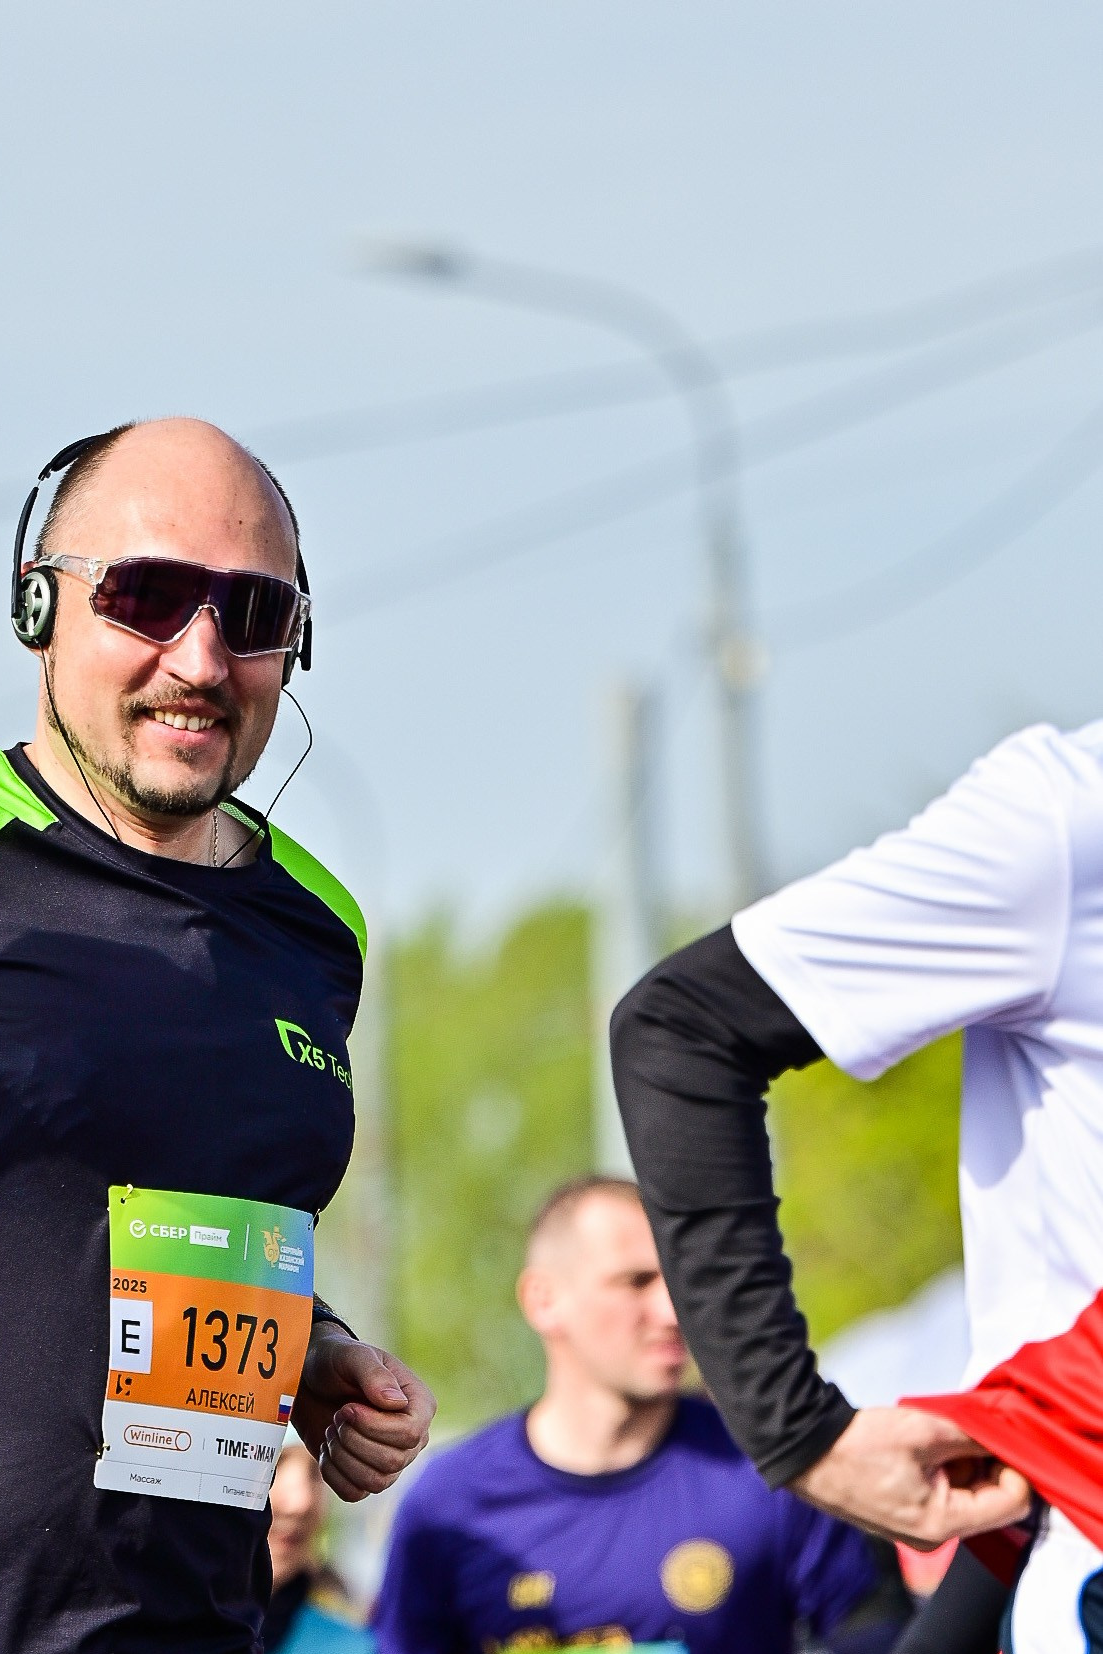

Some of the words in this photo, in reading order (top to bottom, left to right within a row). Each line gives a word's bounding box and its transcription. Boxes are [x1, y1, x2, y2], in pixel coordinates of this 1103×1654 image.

[297, 1041, 326, 1071] X5
[149, 1224, 188, 1239] СБЕР
[194, 1231, 222, 1242] Прайм
[112, 1277, 147, 1294] 2025
[121, 1319, 141, 1355] E
[182, 1306, 279, 1380] 1373
[185, 1387, 255, 1414] АЛЕКСЕЙ
[129, 1429, 173, 1445] Winline
[129, 1473, 162, 1486] Массаж
